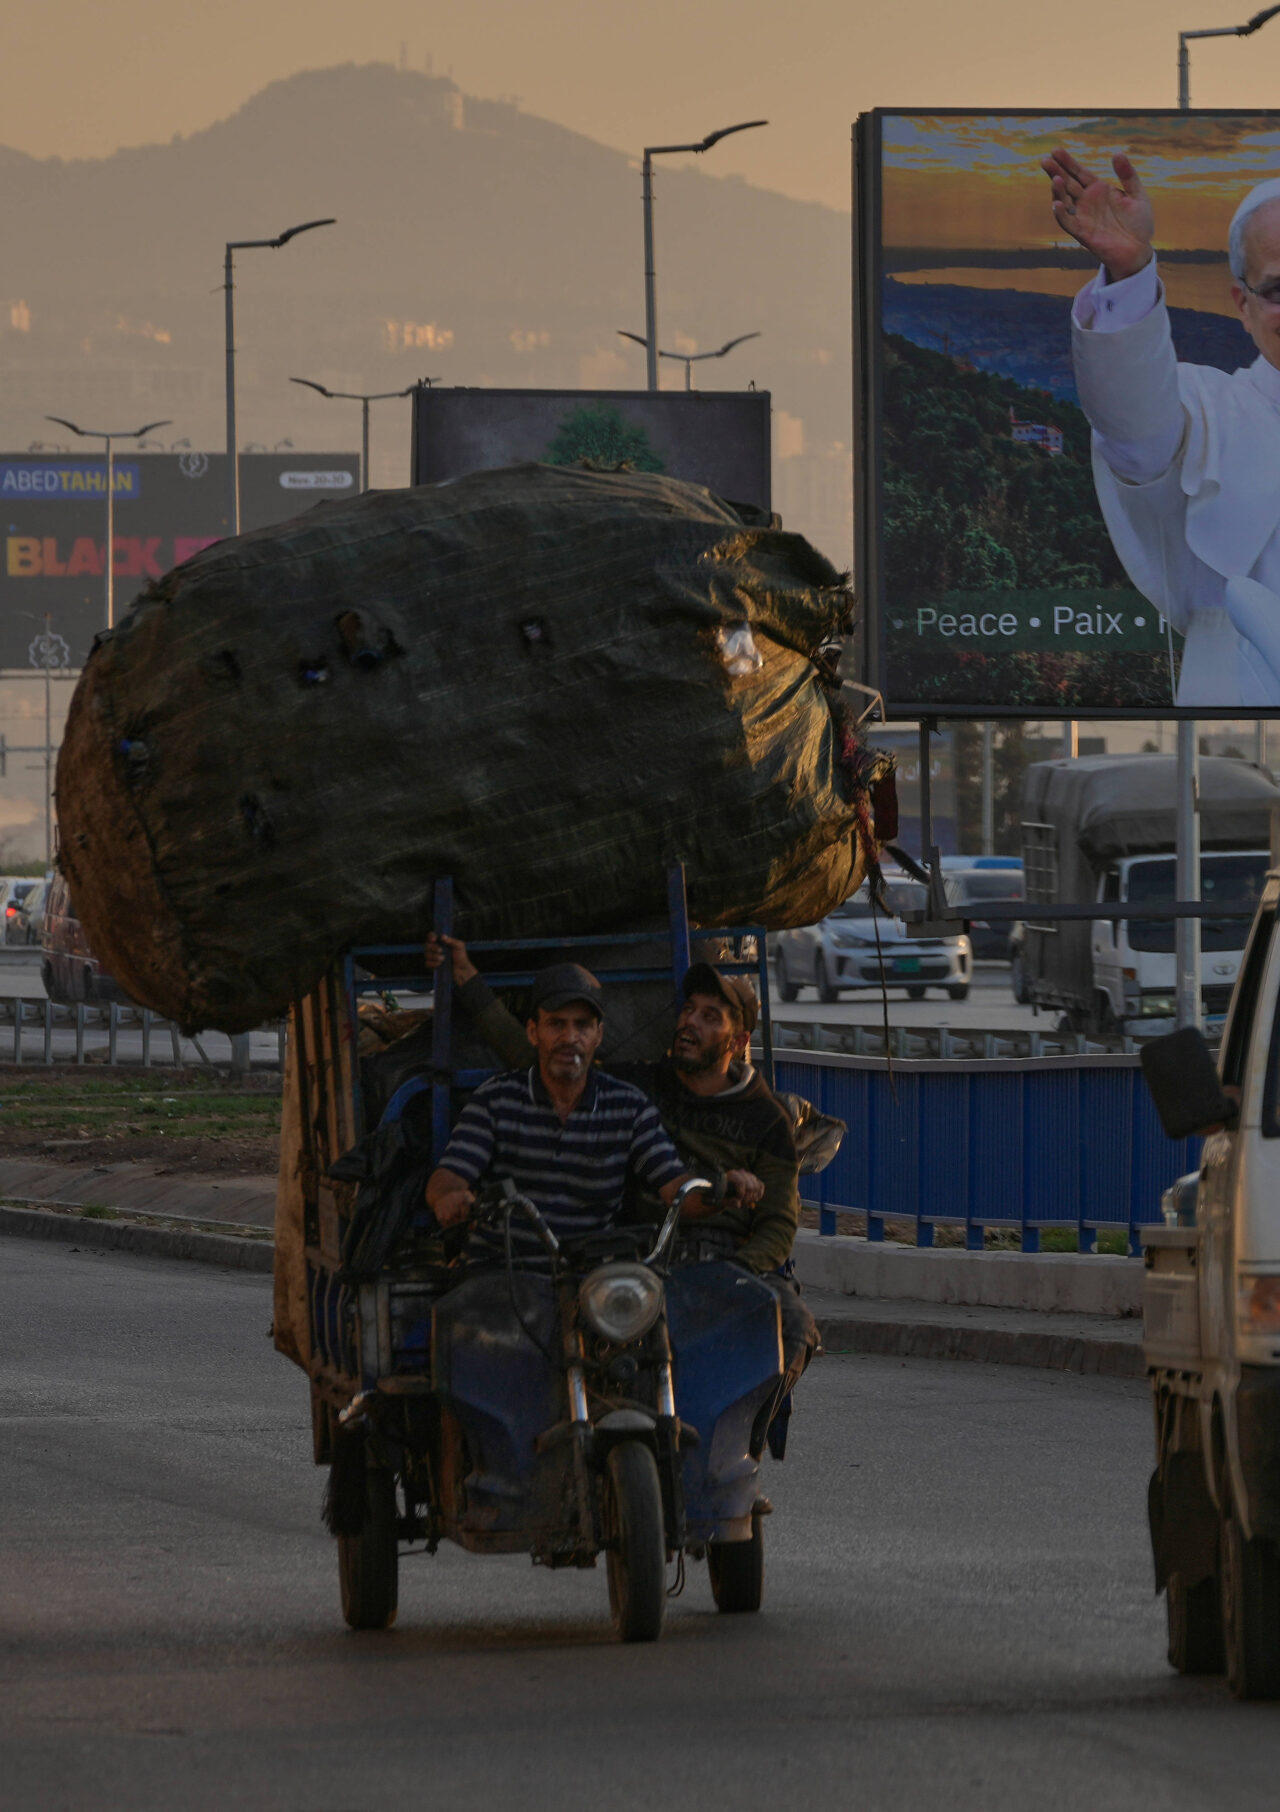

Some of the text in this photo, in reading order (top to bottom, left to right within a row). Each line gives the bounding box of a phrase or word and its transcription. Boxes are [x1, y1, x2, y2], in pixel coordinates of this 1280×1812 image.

[7, 536, 162, 576] BLACK
[917, 606, 1018, 636] Peace
[1054, 604, 1124, 635] Paix
